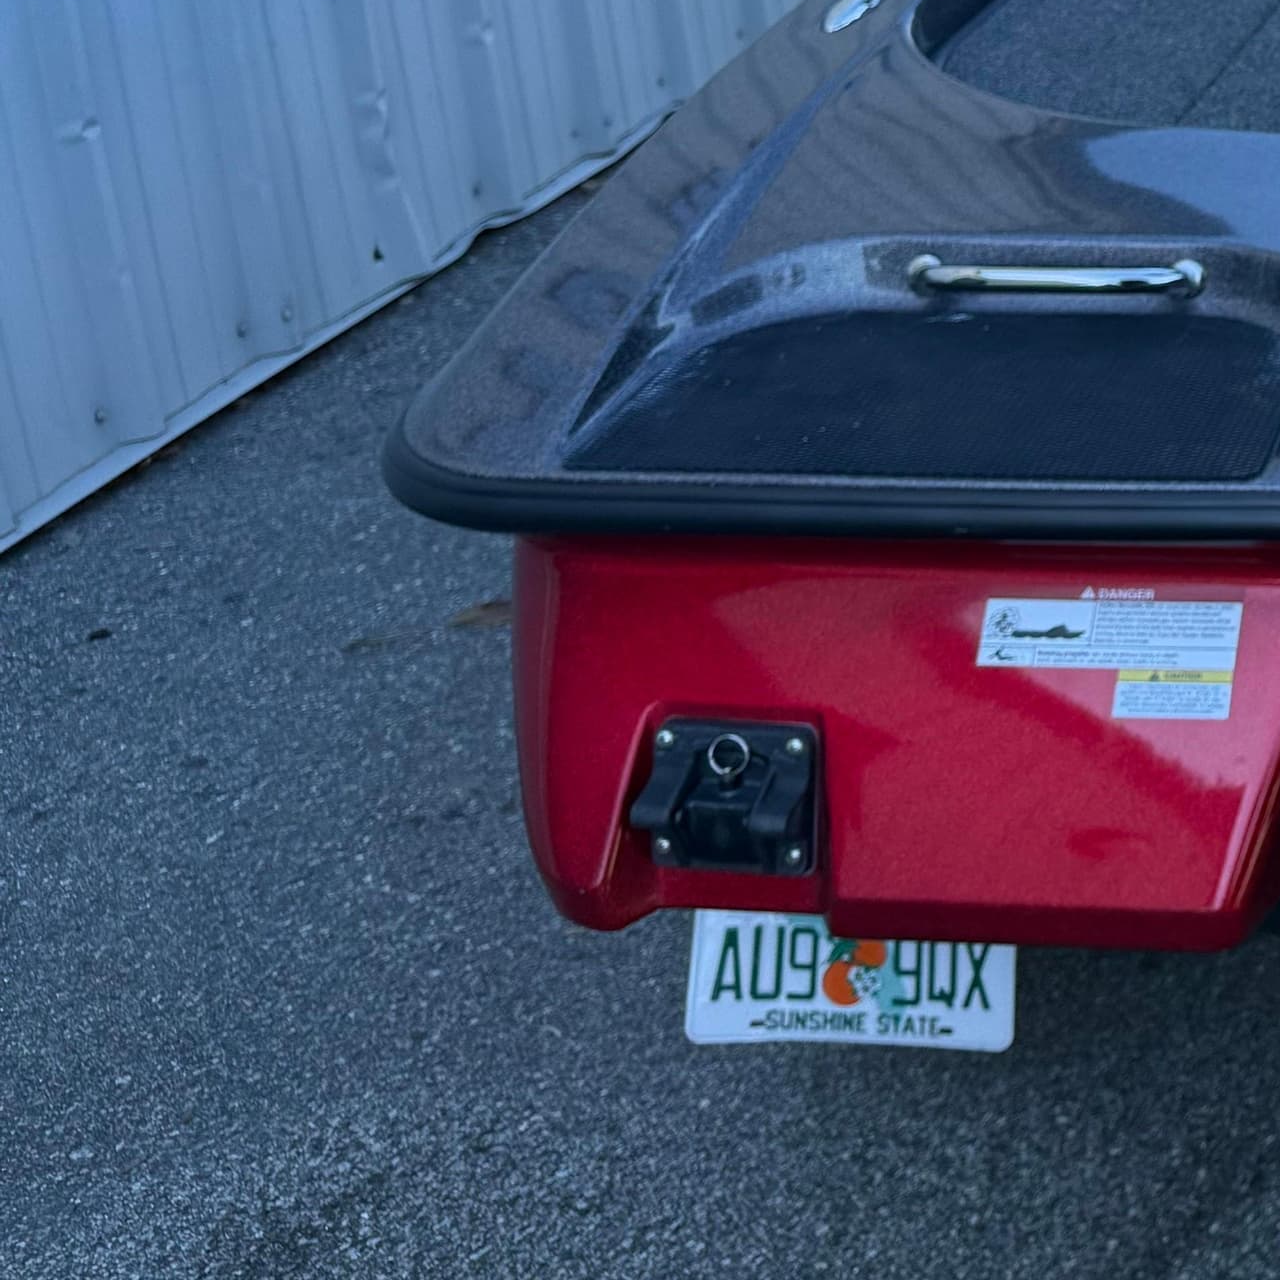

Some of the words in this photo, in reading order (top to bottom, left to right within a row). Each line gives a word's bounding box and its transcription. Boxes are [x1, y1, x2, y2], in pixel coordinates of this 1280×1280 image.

[1097, 587, 1155, 600] DANGER
[711, 924, 821, 1001] AU9
[764, 1009, 866, 1033] SUNSHINE
[877, 1013, 940, 1036] STATE
